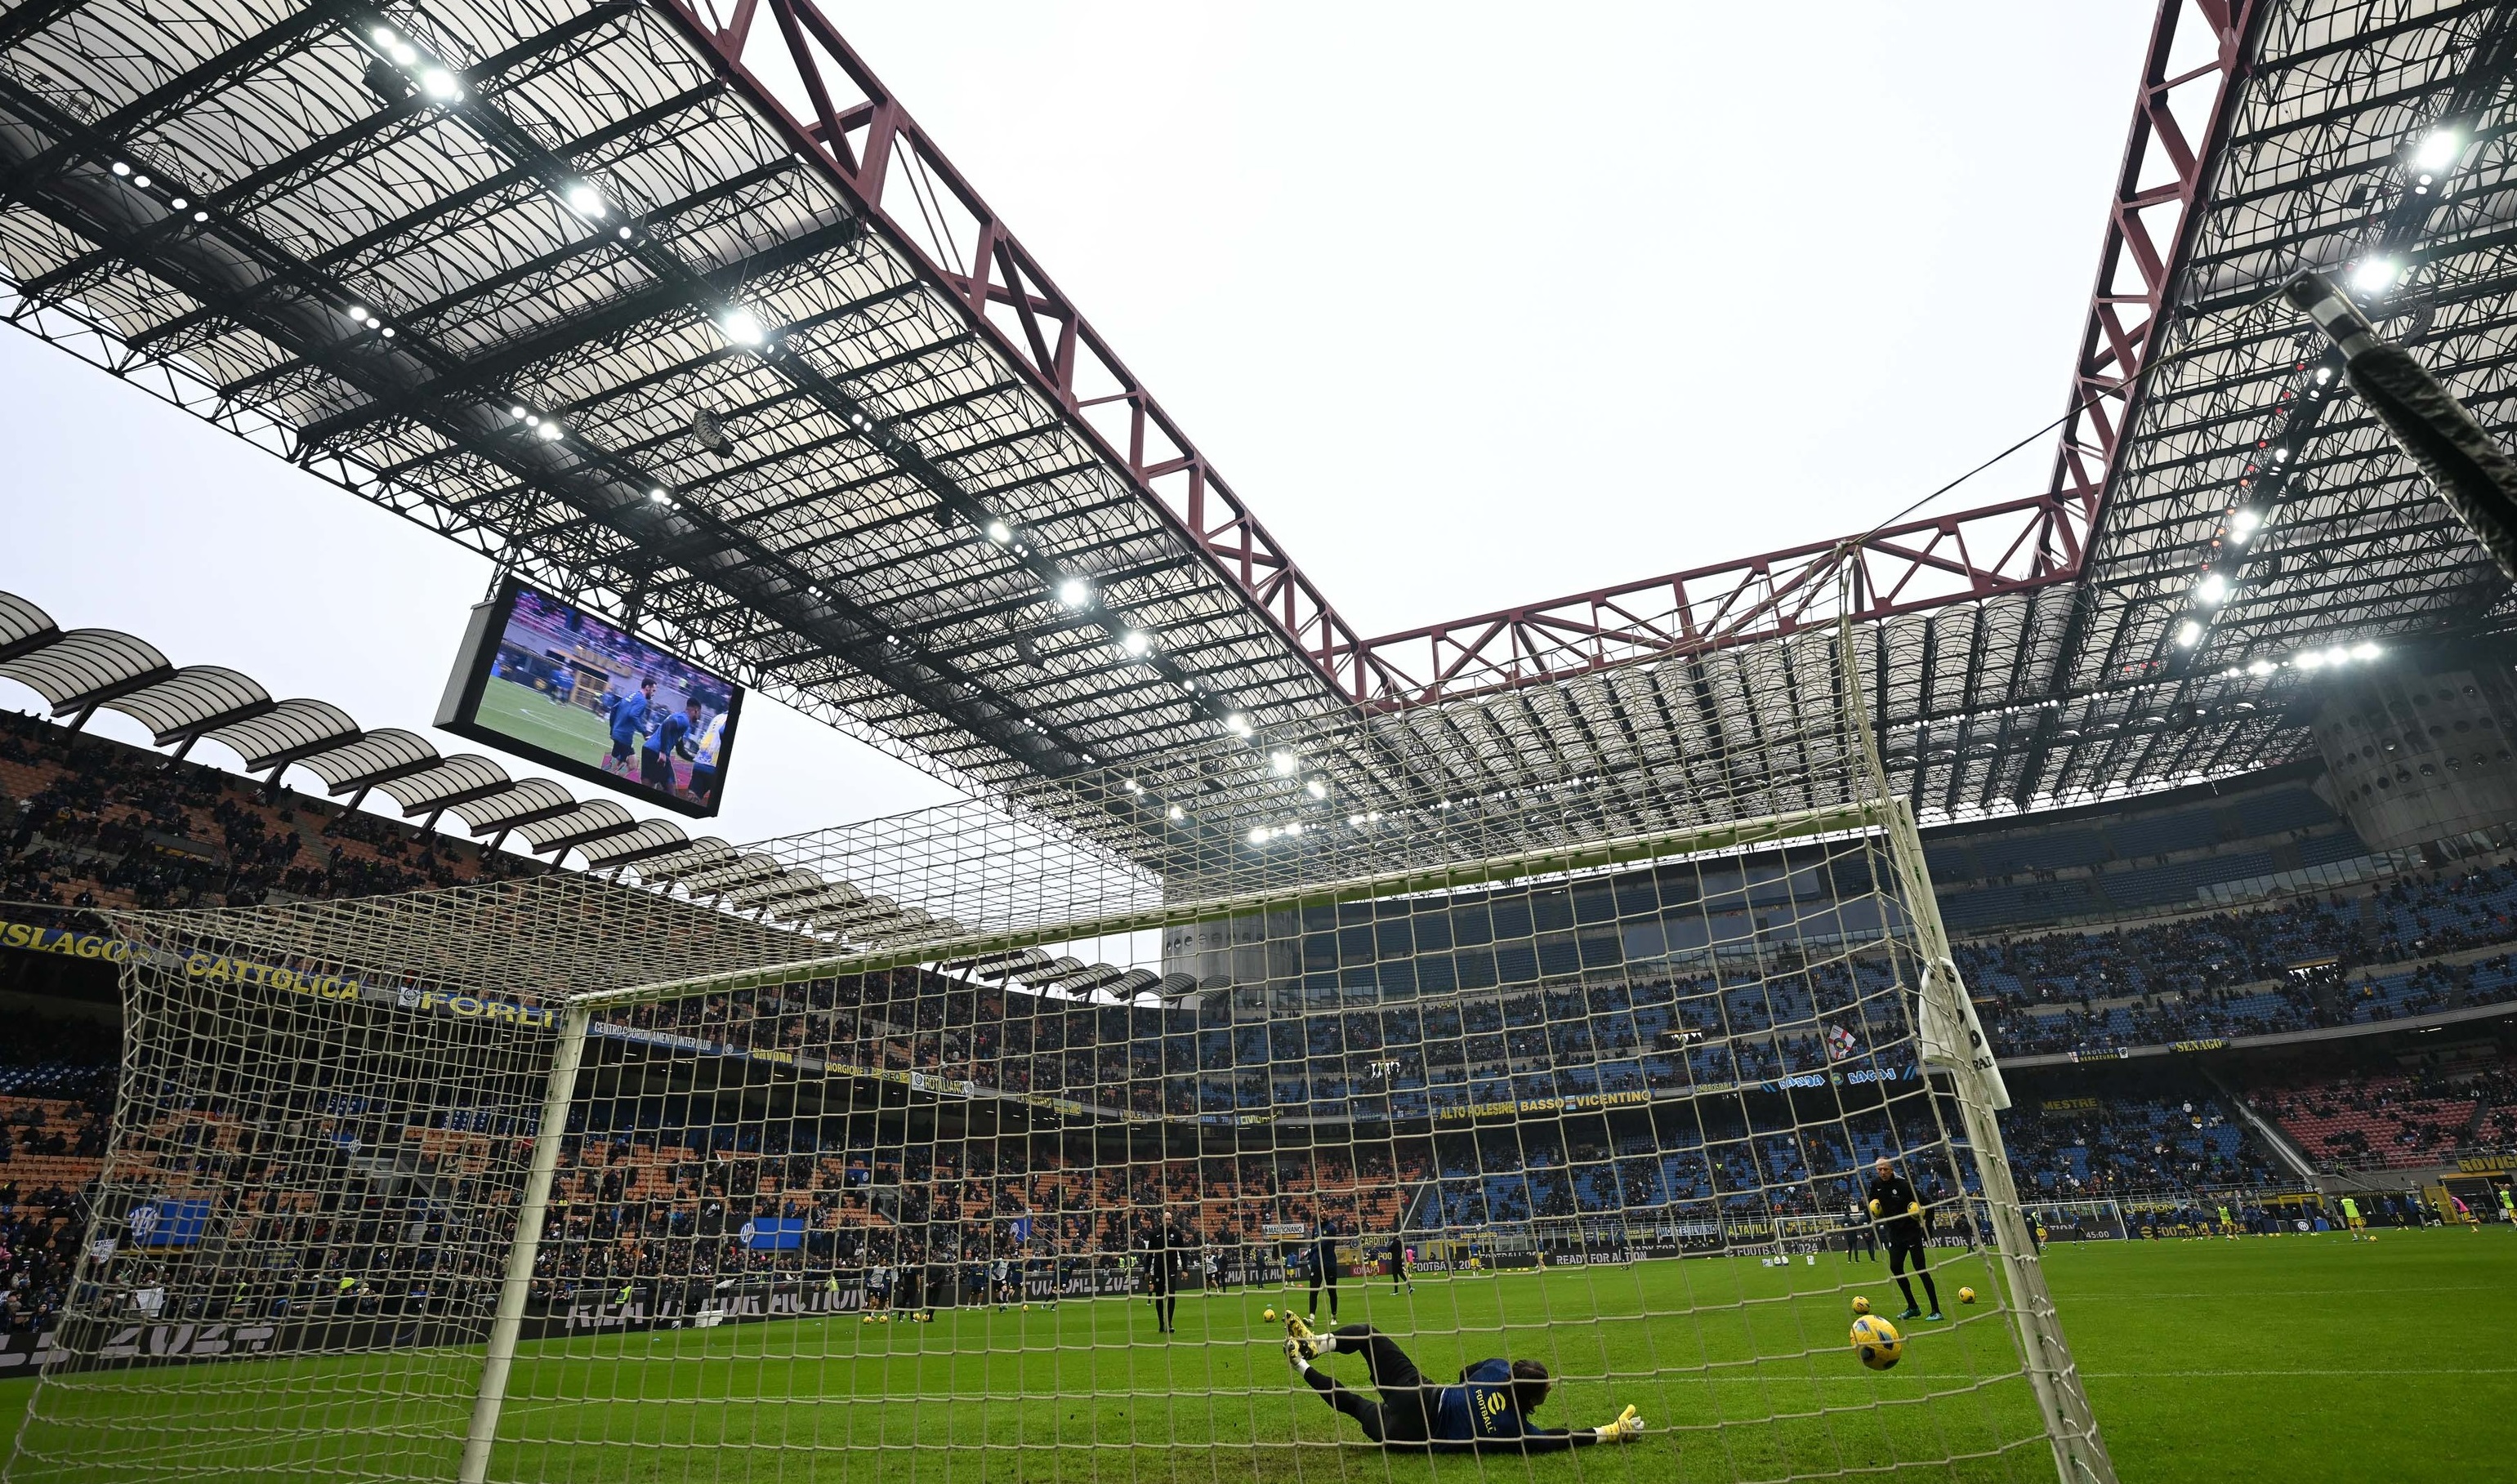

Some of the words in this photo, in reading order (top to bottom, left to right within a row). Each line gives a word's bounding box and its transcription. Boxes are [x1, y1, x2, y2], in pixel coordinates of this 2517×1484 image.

[185, 954, 359, 1001] CATTOLICA
[594, 1021, 623, 1037] CENTRO
[623, 1026, 678, 1045] COORDINAMENTO
[678, 1036, 696, 1049] INTER
[696, 1038, 712, 1051] CLUB
[2082, 1048, 2113, 1056] PAULLO
[2176, 1038, 2223, 1053] SENAGO
[752, 1047, 793, 1064] SAVONA
[825, 1062, 864, 1076] GIORGIONE
[924, 1076, 965, 1094] ROTALIANO
[1778, 1074, 1826, 1090] BANDA
[1847, 1067, 1897, 1085] BAGAJ
[1520, 1097, 1564, 1112] BASSO
[1577, 1090, 1652, 1107] VICENTINO
[2044, 1098, 2097, 1111] MESTRE
[1440, 1106, 1466, 1120] ALTO
[1468, 1101, 1515, 1117] POLESINE
[2457, 1154, 2517, 1172] ROVIG
[1660, 1224, 1716, 1235] MOTESILVANO
[1360, 1237, 1389, 1246] CARDITO
[1738, 1243, 1789, 1256] FOOTBAL
[1412, 1260, 1457, 1272] FOOTBAL
[1556, 1254, 1587, 1265] READY
[1590, 1253, 1609, 1263] FOR
[1612, 1251, 1647, 1263] ATON
[1475, 1389, 1493, 1433] FOOTBALL
